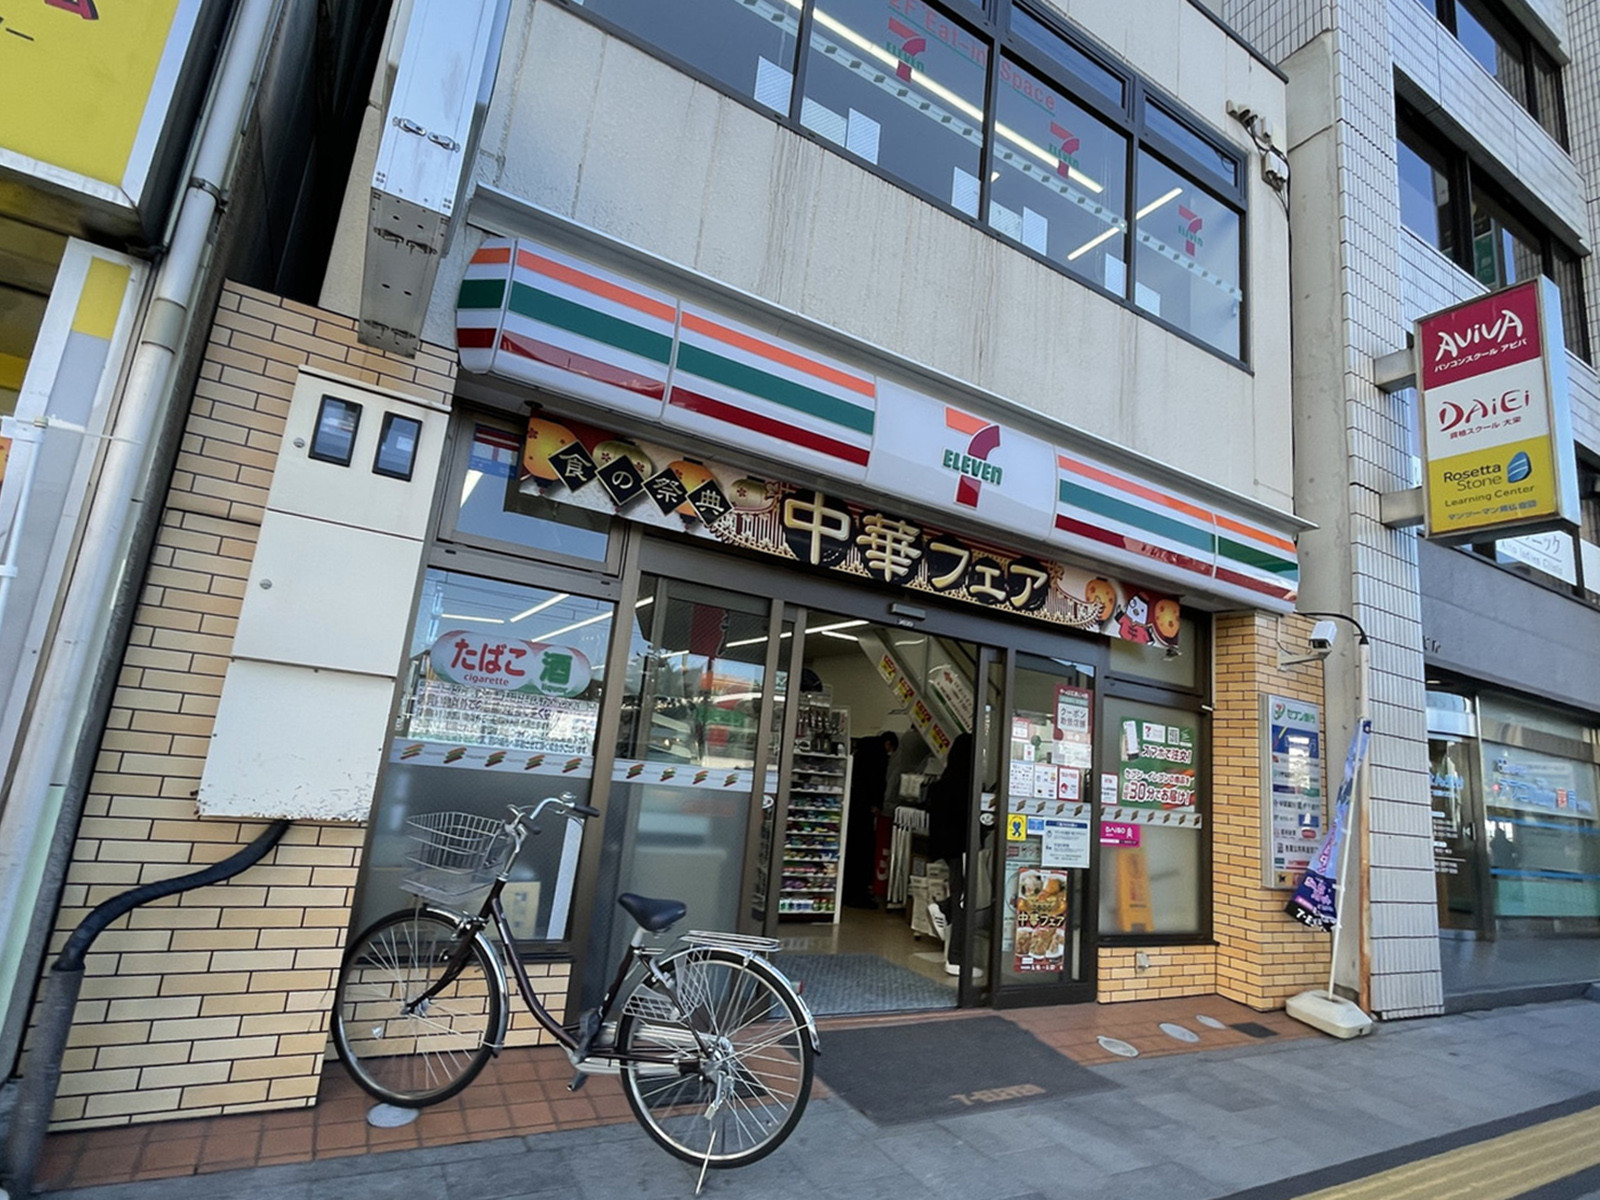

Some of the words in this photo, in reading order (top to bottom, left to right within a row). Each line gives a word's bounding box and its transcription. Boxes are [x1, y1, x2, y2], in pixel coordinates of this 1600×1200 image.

[1000, 59, 1057, 110] Space
[1434, 348, 1499, 373] パソコンスクール
[556, 451, 726, 517] 食の祭典
[1443, 463, 1502, 483] Rosetta
[1456, 474, 1502, 492] Stone
[1444, 492, 1493, 508] Learning
[1494, 485, 1536, 499] Center
[783, 490, 1049, 608] 中華フェア
[451, 638, 527, 677] たばこ
[539, 651, 573, 685] 酒
[463, 673, 510, 687] cigarette
[1060, 706, 1087, 719] クーポン
